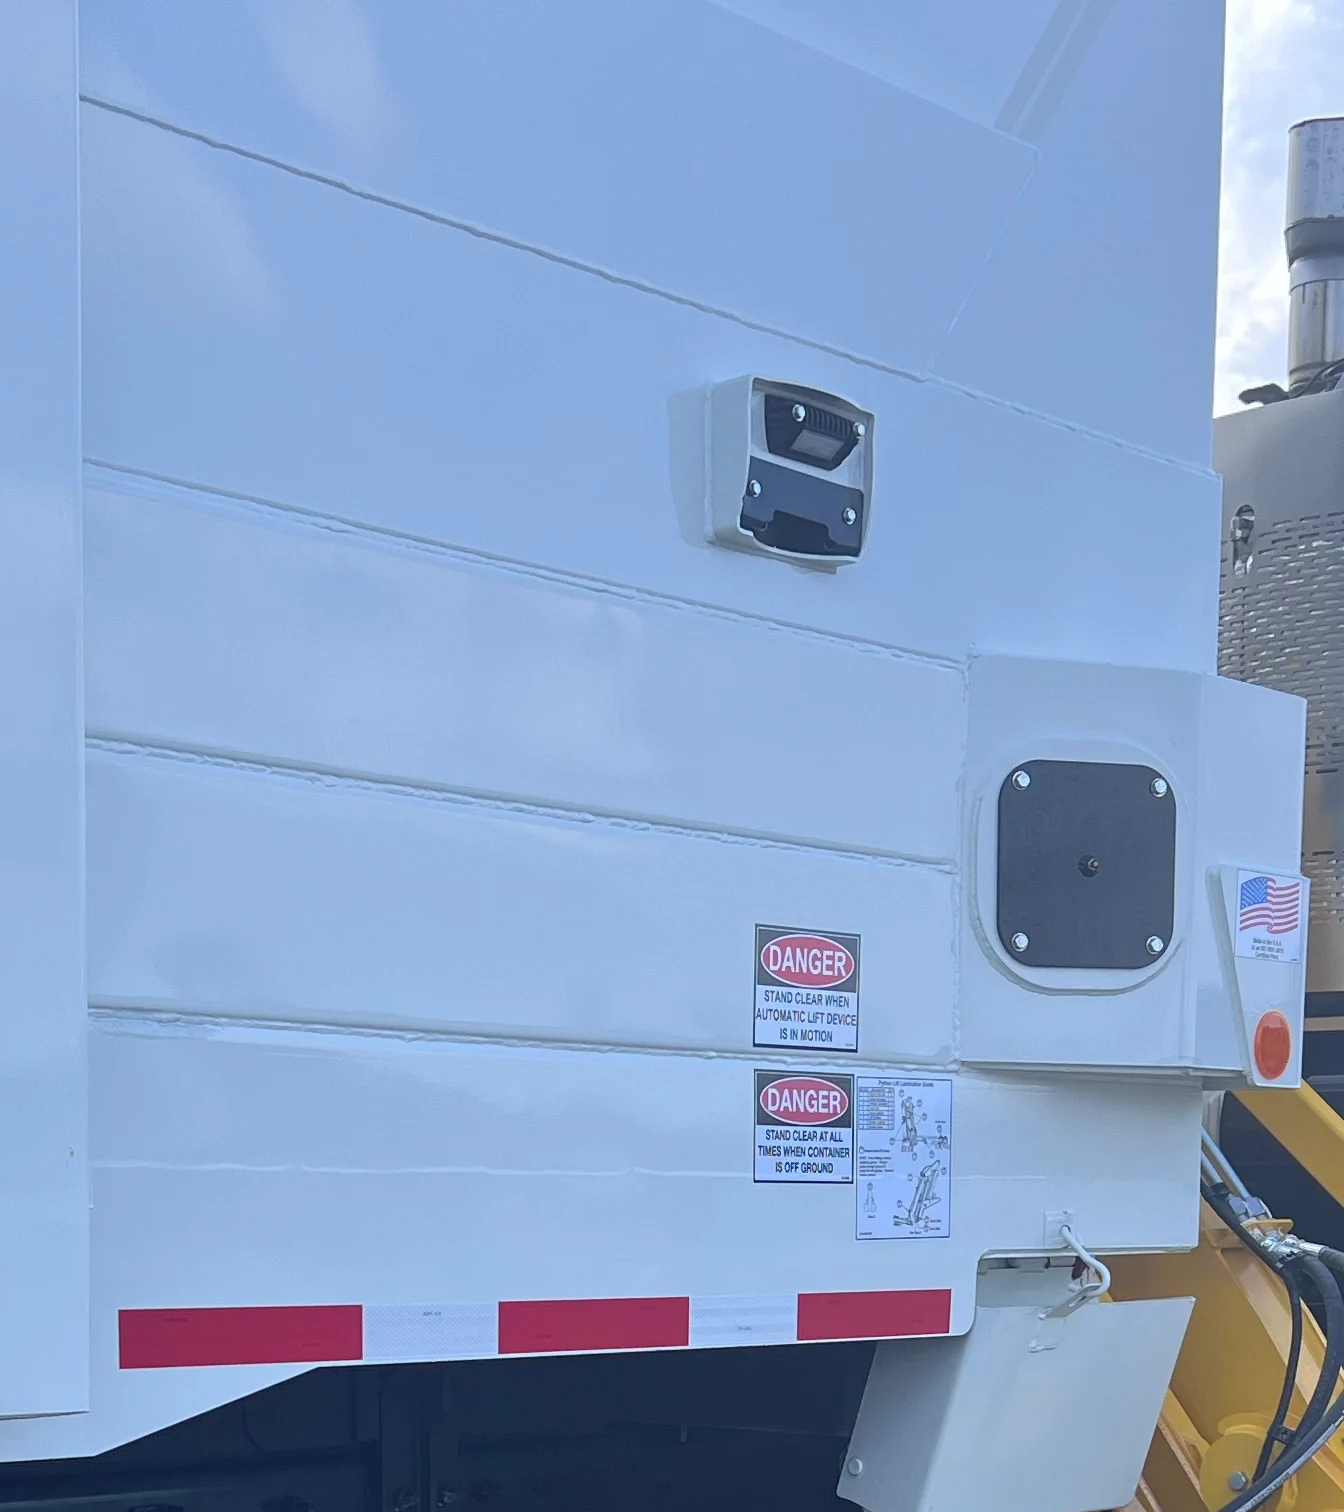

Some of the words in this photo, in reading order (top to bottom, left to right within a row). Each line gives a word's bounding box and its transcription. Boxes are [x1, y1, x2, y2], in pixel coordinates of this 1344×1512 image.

[768, 943, 847, 977] DANGER
[764, 990, 793, 1005] STAND
[795, 992, 823, 1007] CLEAR
[825, 993, 850, 1008] WHEN
[756, 1008, 805, 1024] AUTOMATIC
[808, 1010, 825, 1025] LIFT
[826, 1012, 856, 1026] DEVICE
[779, 1028, 788, 1041] IS
[790, 1028, 799, 1041] IN
[800, 1029, 833, 1043] MOTION
[765, 1086, 842, 1114] DANGER
[765, 1129, 791, 1141] STAND
[792, 1130, 814, 1142] CLEAR
[816, 1131, 826, 1142] AT
[827, 1131, 843, 1143] ALL
[758, 1145, 781, 1157] TIMES
[782, 1146, 805, 1158] WHEN
[806, 1146, 850, 1159] CONTAINER
[775, 1162, 783, 1173] IS
[784, 1162, 799, 1173] OFF
[800, 1162, 834, 1174] GROUND
